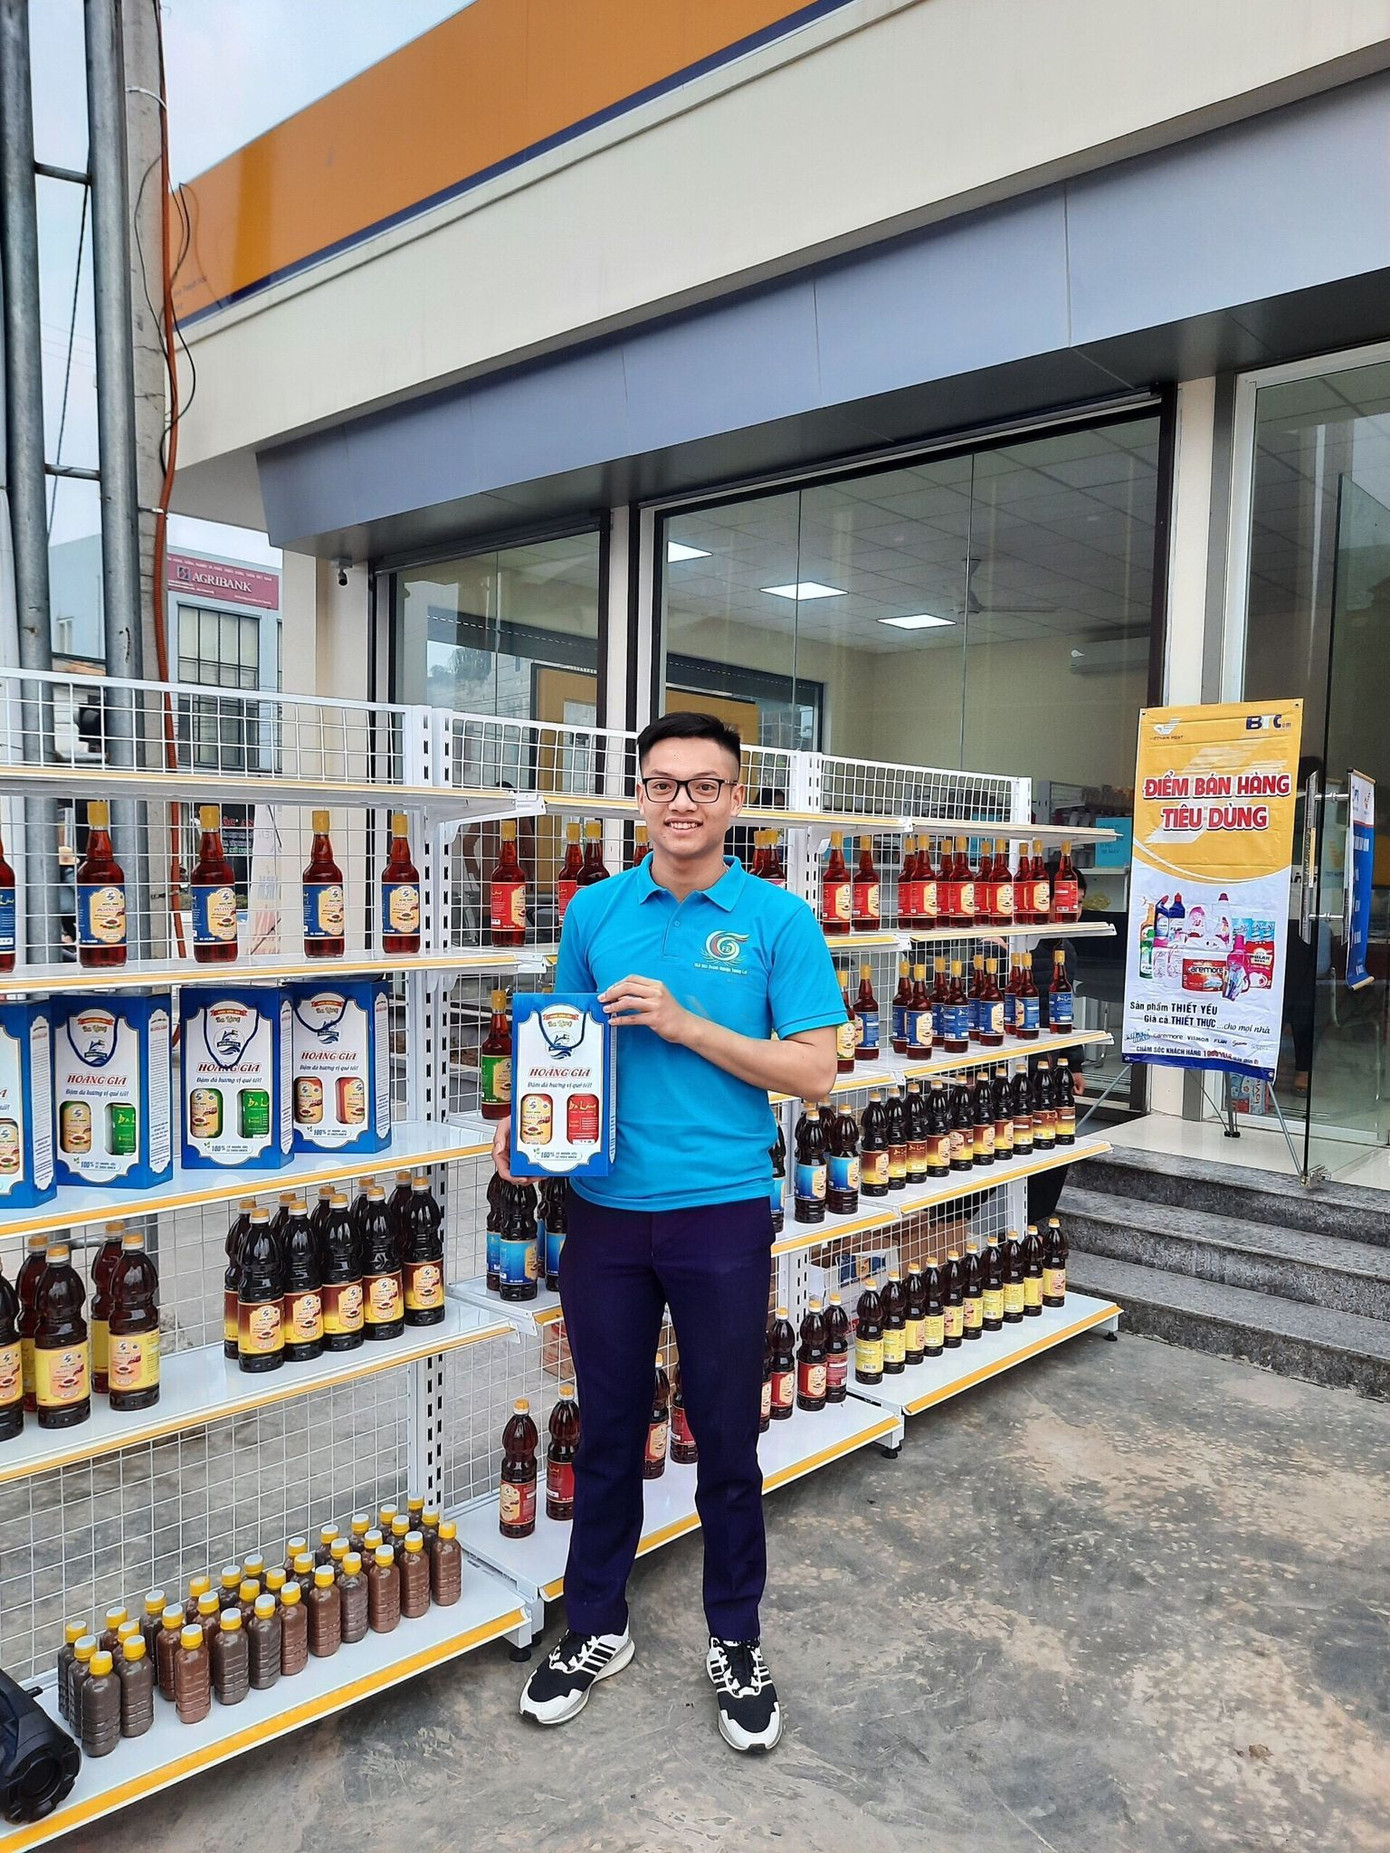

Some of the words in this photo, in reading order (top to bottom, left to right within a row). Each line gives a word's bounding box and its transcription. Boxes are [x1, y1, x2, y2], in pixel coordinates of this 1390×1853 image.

[192, 572, 252, 592] AGRIBANK
[1144, 771, 1189, 797] ĐIỂM
[1195, 773, 1231, 796] BÁN
[1237, 771, 1290, 795] HÀNG
[1162, 804, 1203, 829] TIÊU
[1209, 803, 1267, 828] DÙNG
[1130, 1001, 1144, 1010] Sản
[1146, 1002, 1168, 1011] phẩm
[1171, 1001, 1197, 1014] THIẾT
[1201, 1003, 1218, 1015] YẾU
[1171, 1015, 1194, 1026] THIẾT
[1196, 1017, 1216, 1028] THỰC
[1238, 1024, 1253, 1033] mọi
[1254, 1026, 1270, 1034] nhà
[338, 1052, 356, 1060] GIA
[1166, 1047, 1185, 1055] KHÁCH
[240, 1064, 260, 1072] GIA
[570, 1068, 591, 1077] GIA
[107, 1076, 127, 1085] GIA
